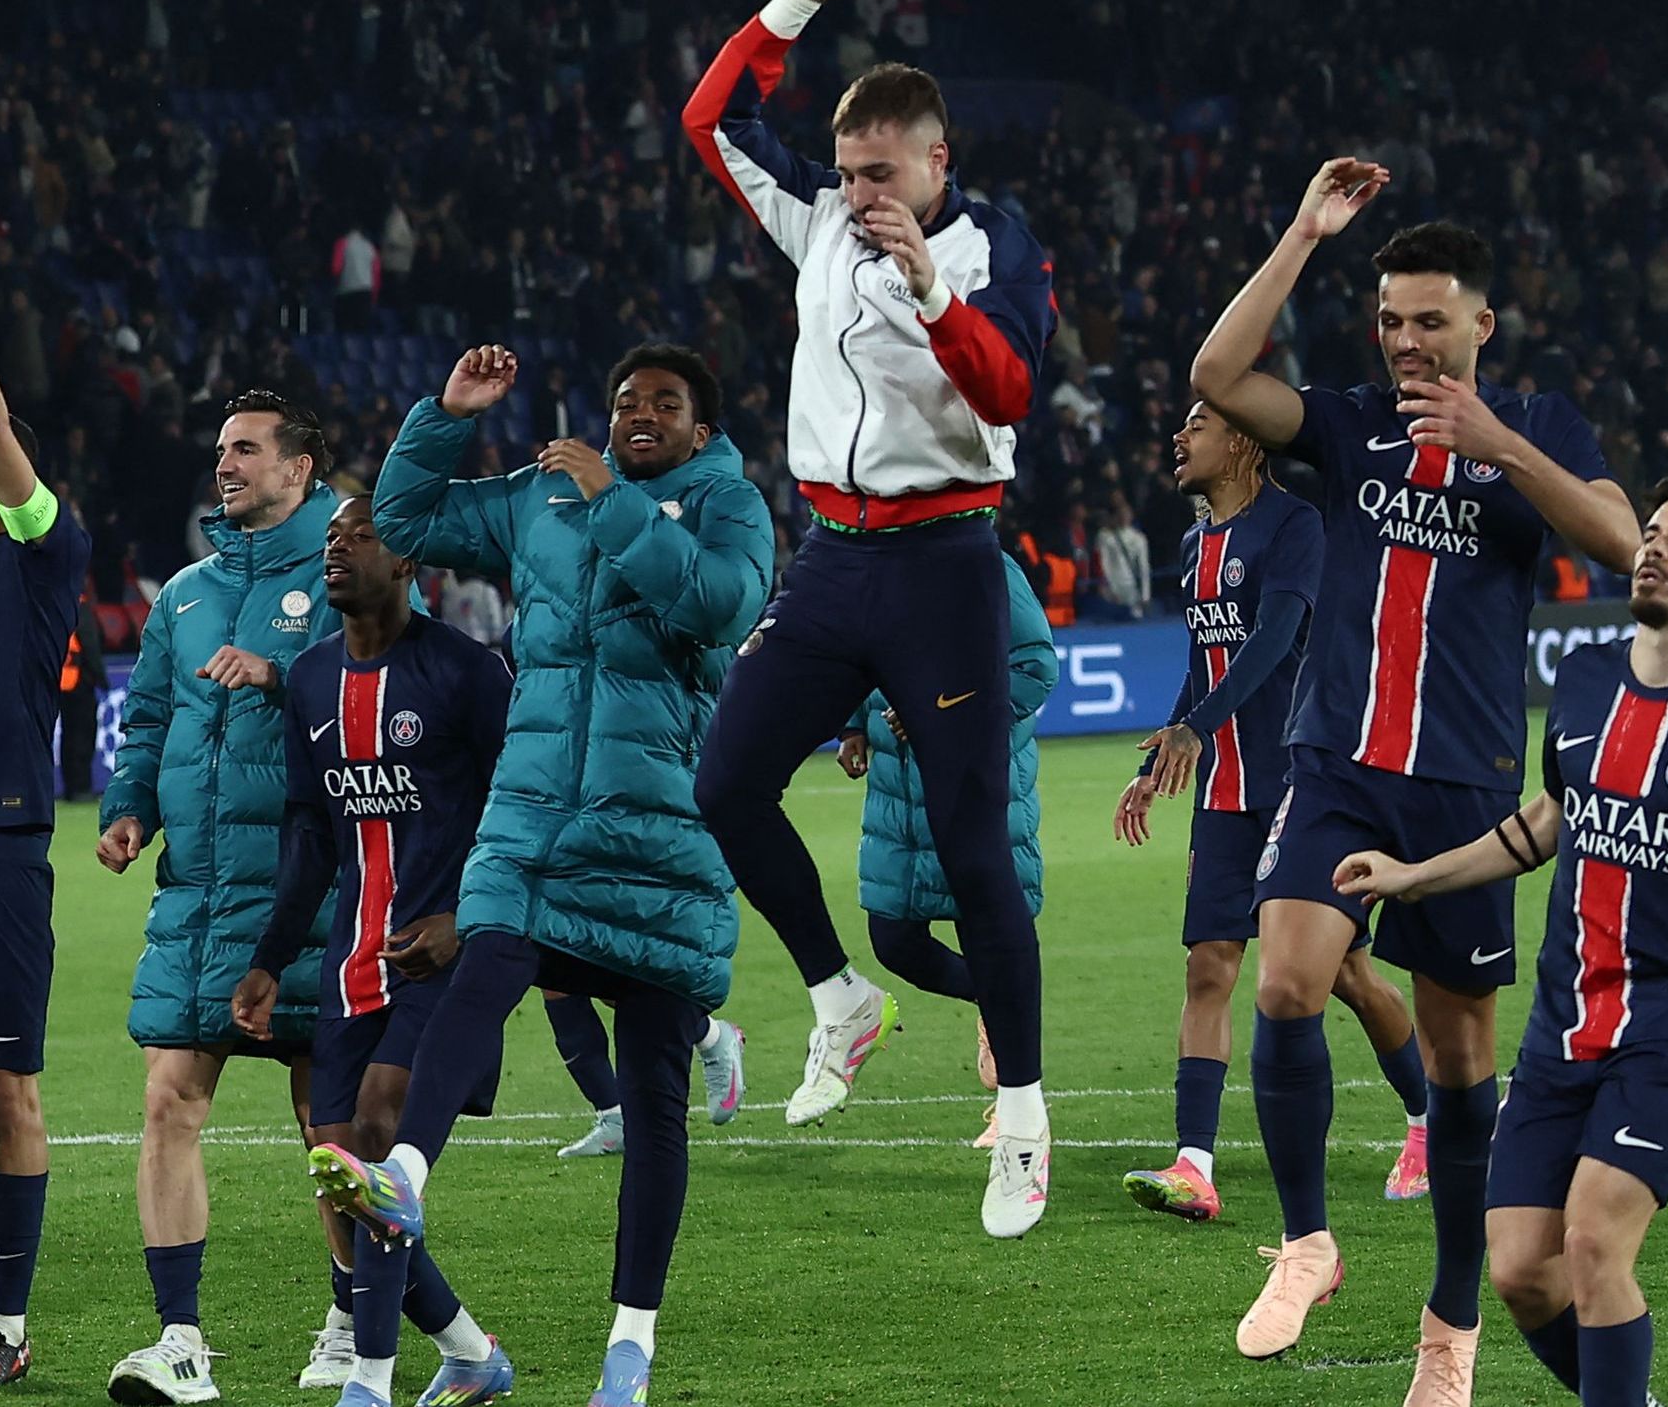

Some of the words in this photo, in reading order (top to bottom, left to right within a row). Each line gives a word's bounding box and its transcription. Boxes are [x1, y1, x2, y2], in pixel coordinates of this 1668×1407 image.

[1358, 479, 1481, 534] QATAR
[1378, 518, 1479, 557] AIRWAYS
[271, 617, 309, 630] QATAR
[323, 764, 419, 797] QATAR
[343, 793, 422, 817] AIRWAYS
